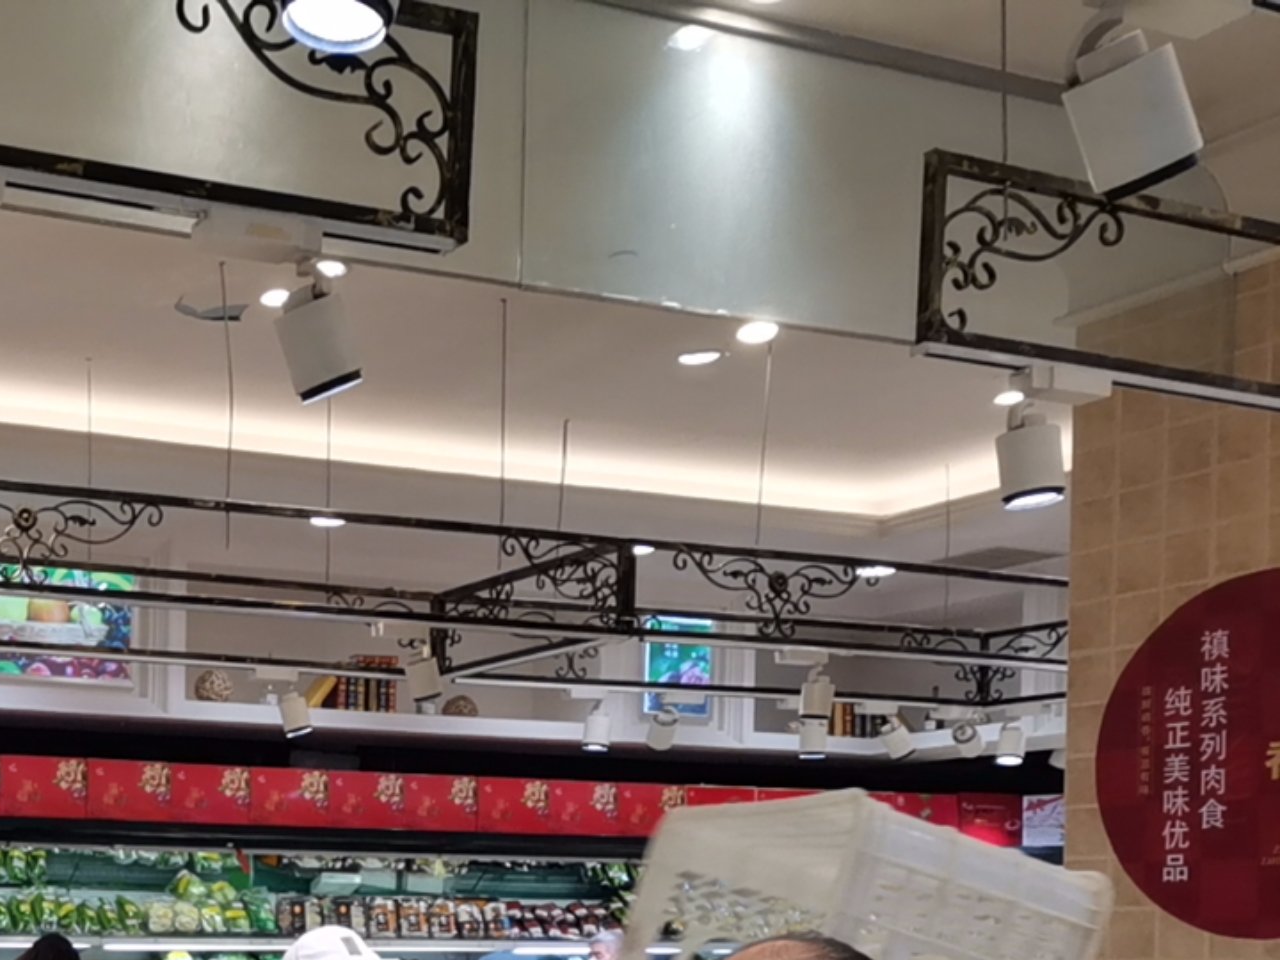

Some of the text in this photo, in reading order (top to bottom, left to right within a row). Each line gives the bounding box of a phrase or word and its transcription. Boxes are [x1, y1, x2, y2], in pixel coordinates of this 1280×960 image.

[1162, 686, 1193, 882] 纯正美味优品
